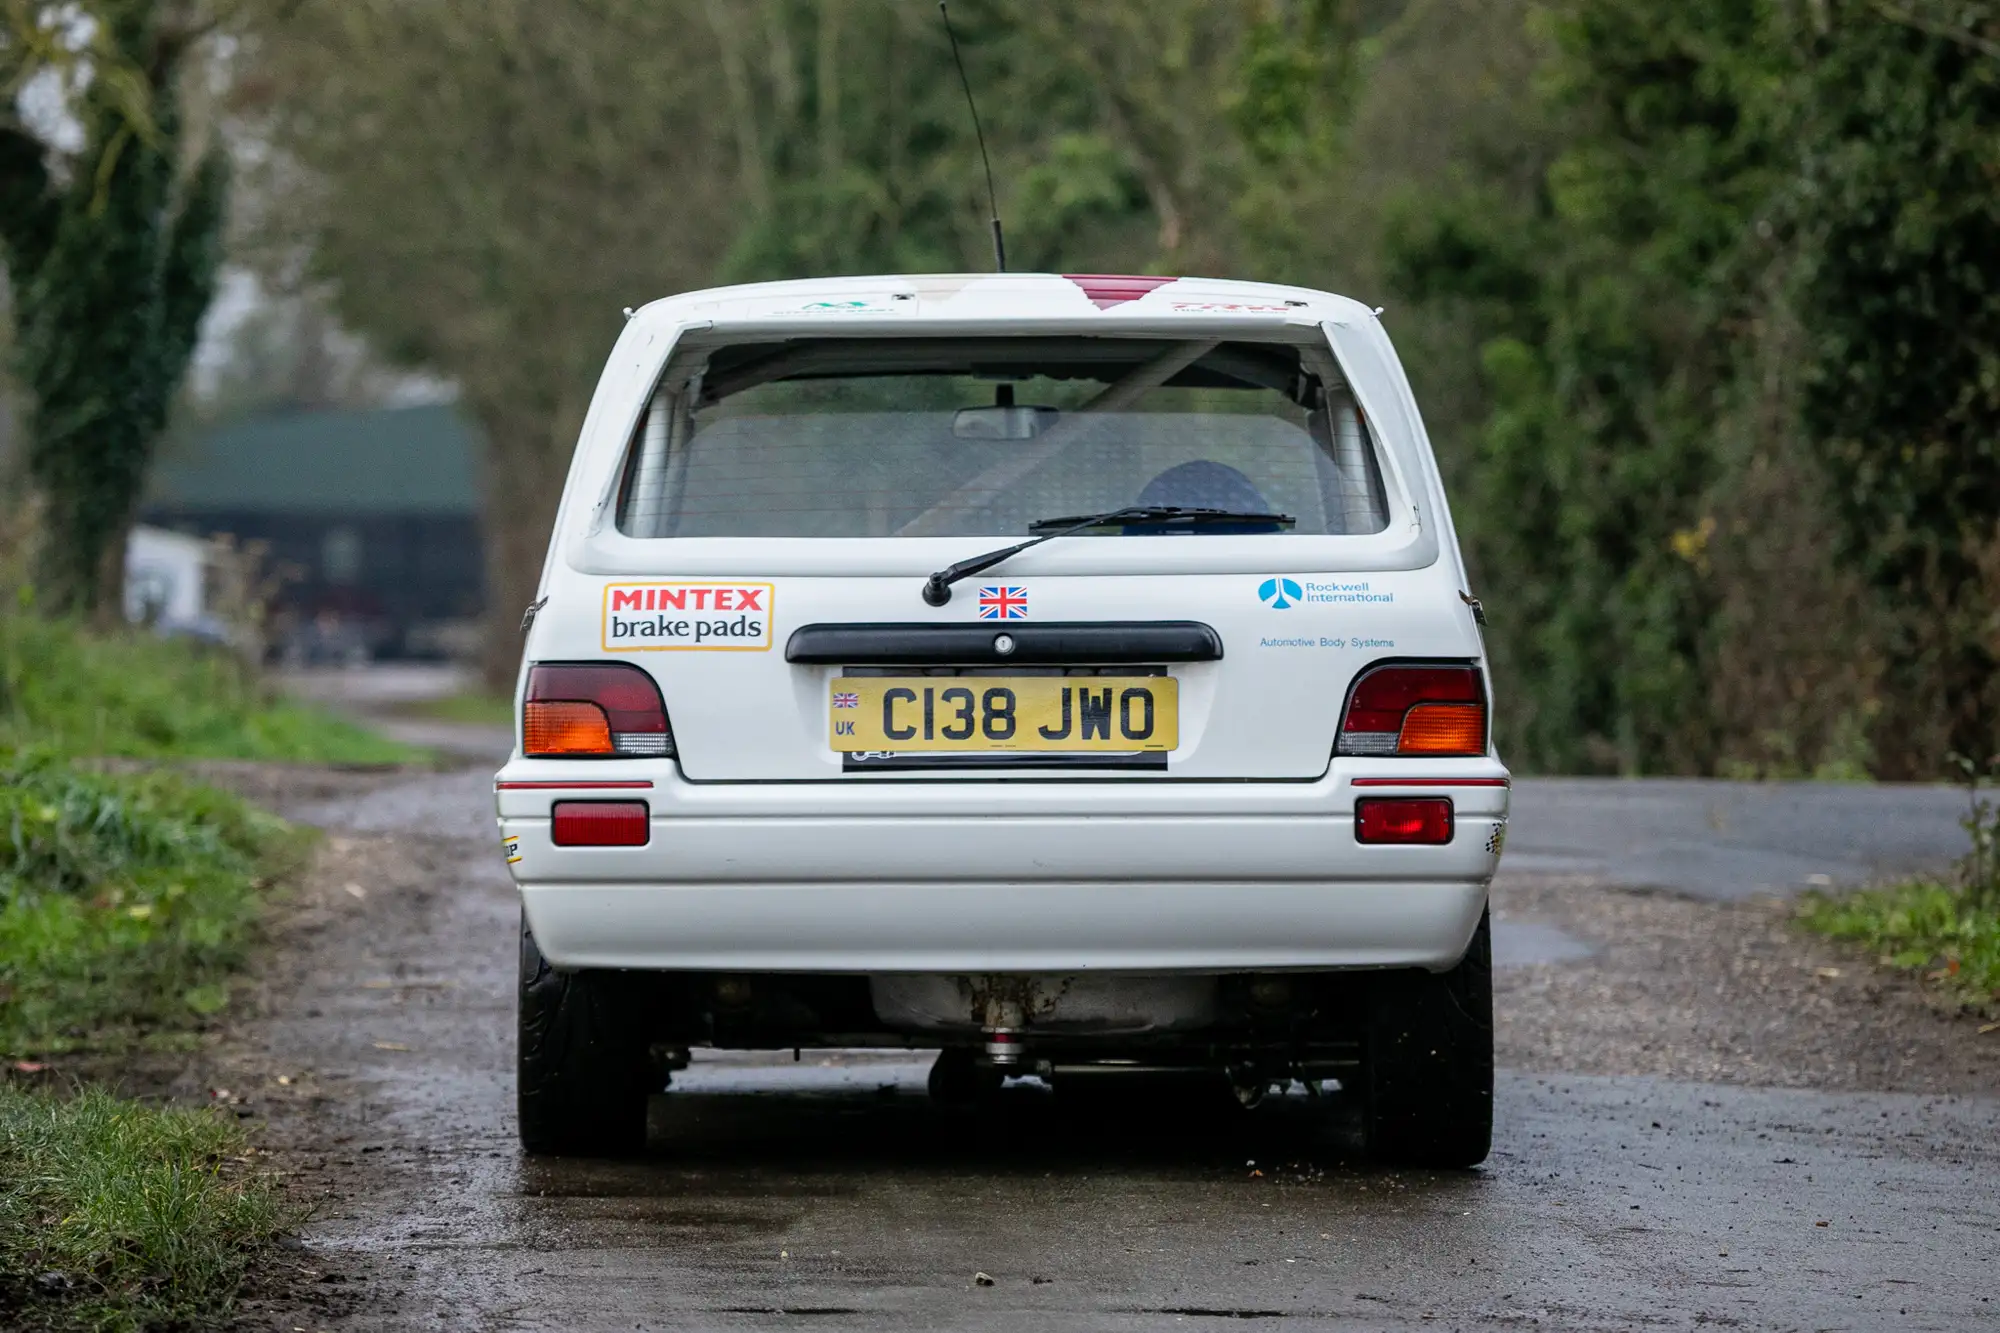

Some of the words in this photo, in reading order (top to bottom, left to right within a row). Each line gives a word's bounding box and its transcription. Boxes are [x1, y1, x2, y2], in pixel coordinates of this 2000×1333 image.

[1305, 582, 1369, 592] Rockwell
[611, 589, 763, 611] MINTEX
[1307, 593, 1394, 602] International
[612, 615, 690, 638] brake
[695, 615, 762, 643] pads
[1260, 637, 1315, 647] Automotive
[1320, 637, 1346, 649] Body
[1351, 637, 1395, 649] Systems
[882, 687, 1017, 740] C138
[1038, 687, 1155, 740] JWO
[835, 721, 856, 736] UK
